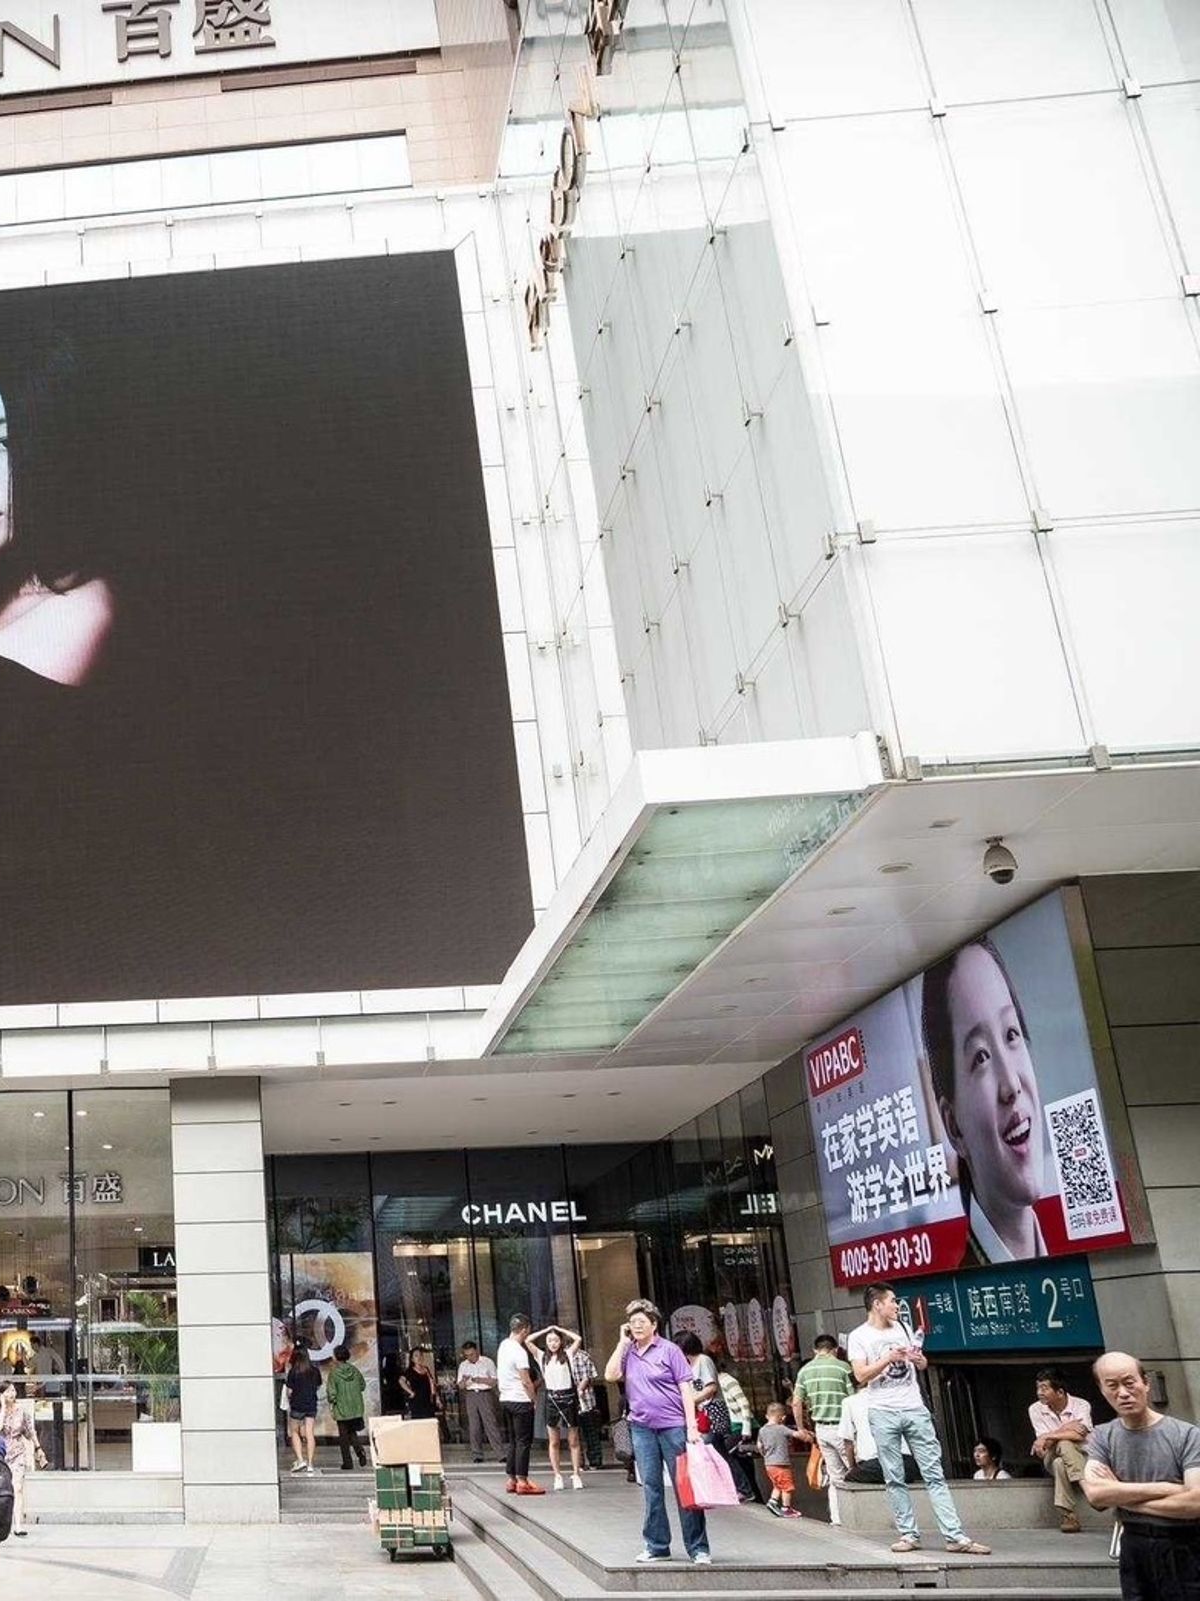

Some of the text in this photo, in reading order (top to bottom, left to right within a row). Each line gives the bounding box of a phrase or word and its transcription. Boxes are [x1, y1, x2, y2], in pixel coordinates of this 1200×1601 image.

[102, 0, 276, 63] 百盛
[809, 1035, 860, 1089] VIPABC
[821, 1086, 920, 1172] 在家学英语
[59, 1170, 124, 1204] 百盛
[846, 1143, 951, 1224] 游学全世界
[461, 1201, 587, 1225] CHANEL
[967, 1283, 1031, 1319] 陕西南路
[1041, 1277, 1064, 1329] 2
